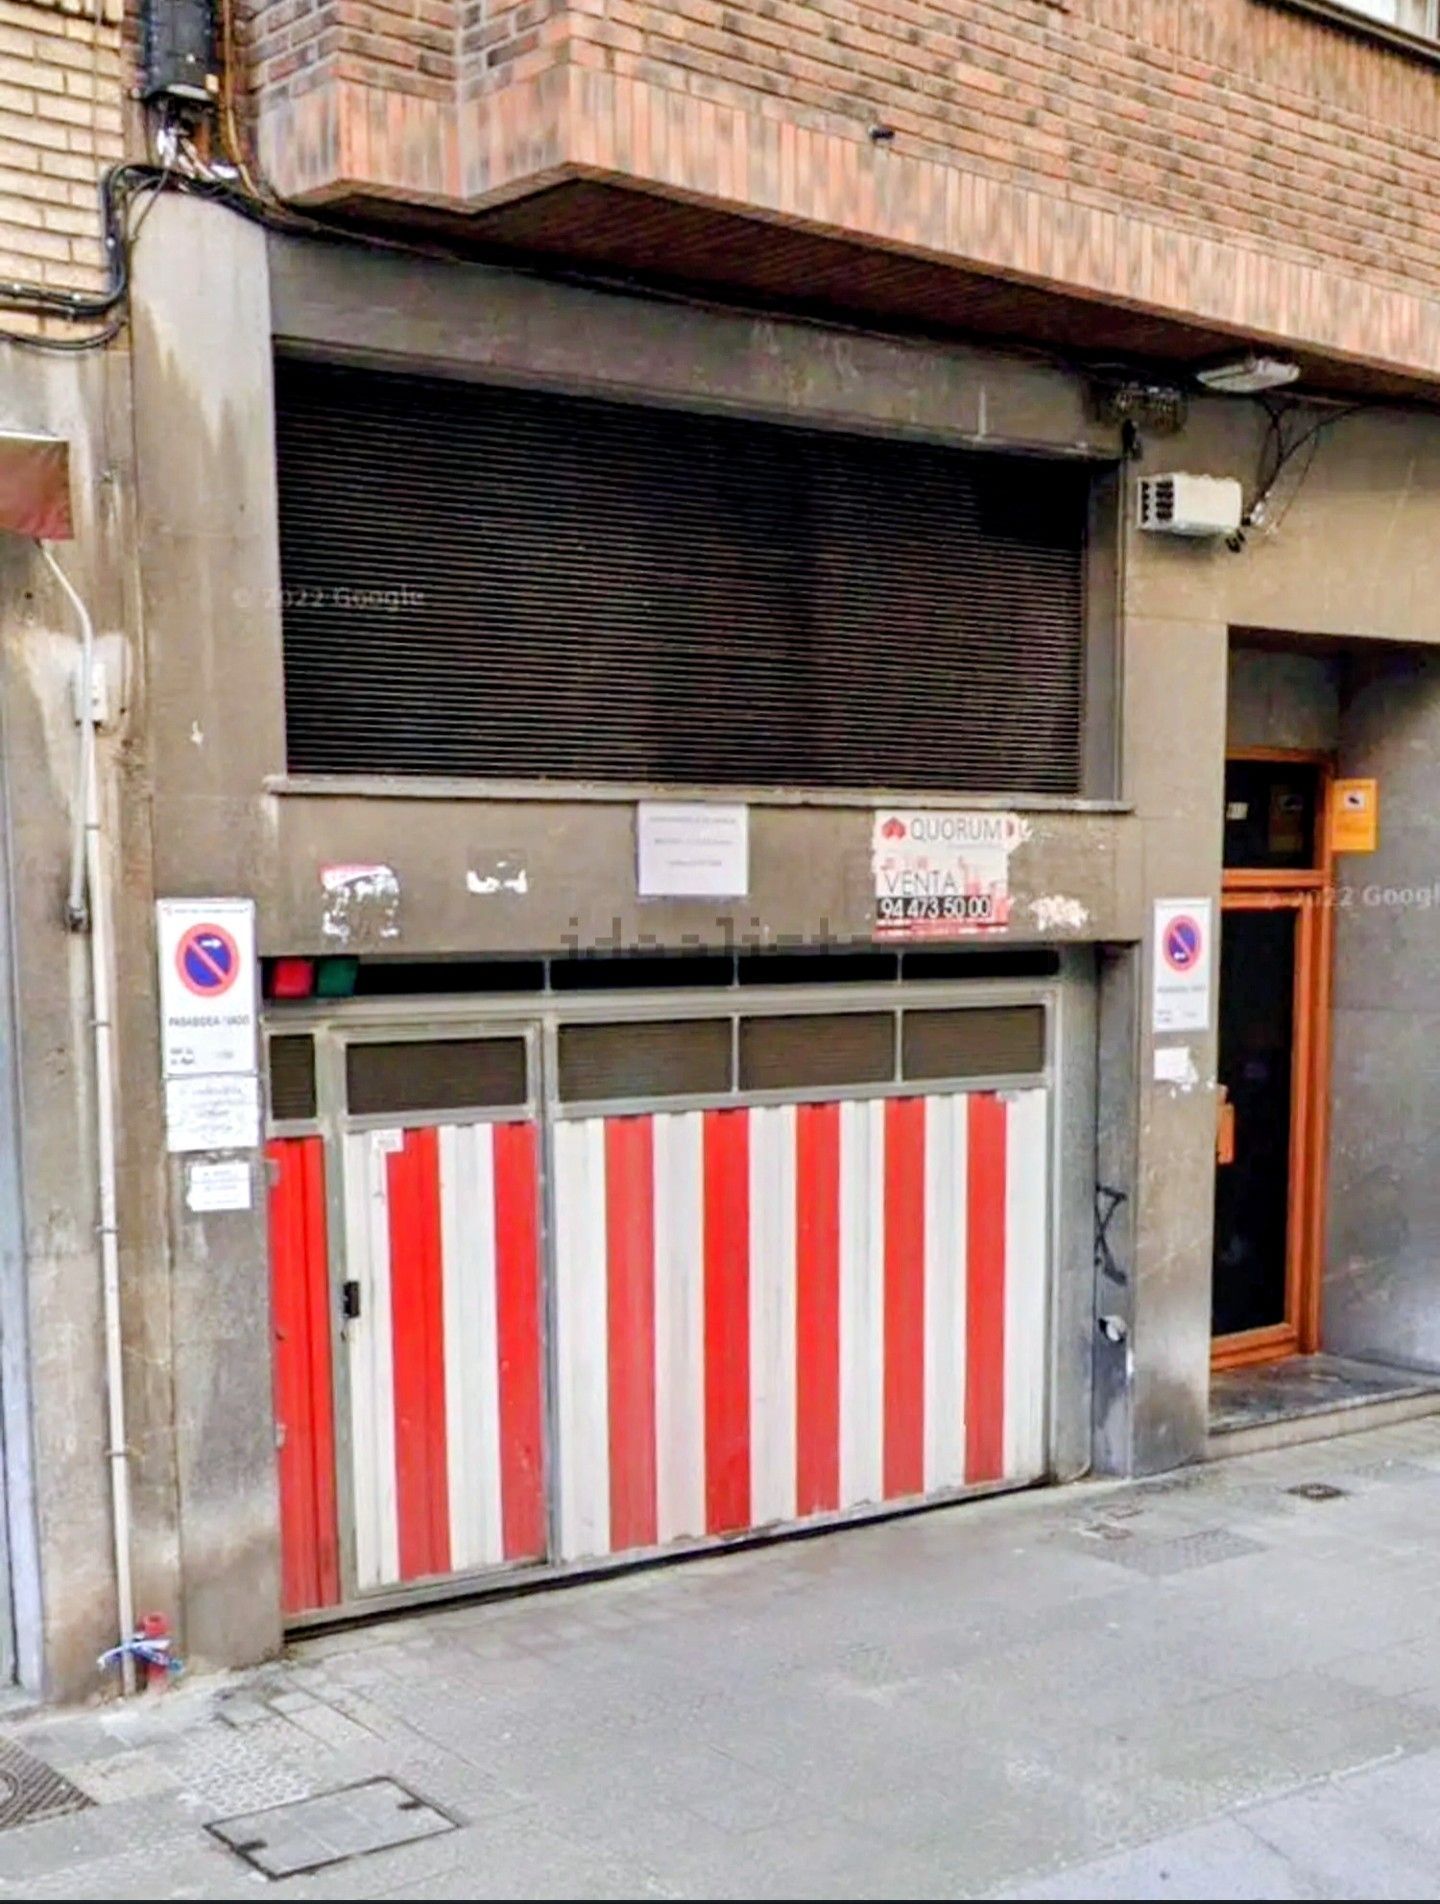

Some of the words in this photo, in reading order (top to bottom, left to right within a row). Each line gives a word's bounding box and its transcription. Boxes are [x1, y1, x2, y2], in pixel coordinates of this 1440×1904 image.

[910, 817, 1001, 842] QUORUM
[884, 869, 958, 896] VENTA
[880, 897, 903, 919] 94
[907, 896, 939, 919] 473
[943, 895, 966, 919] 50
[968, 895, 990, 918] 00
